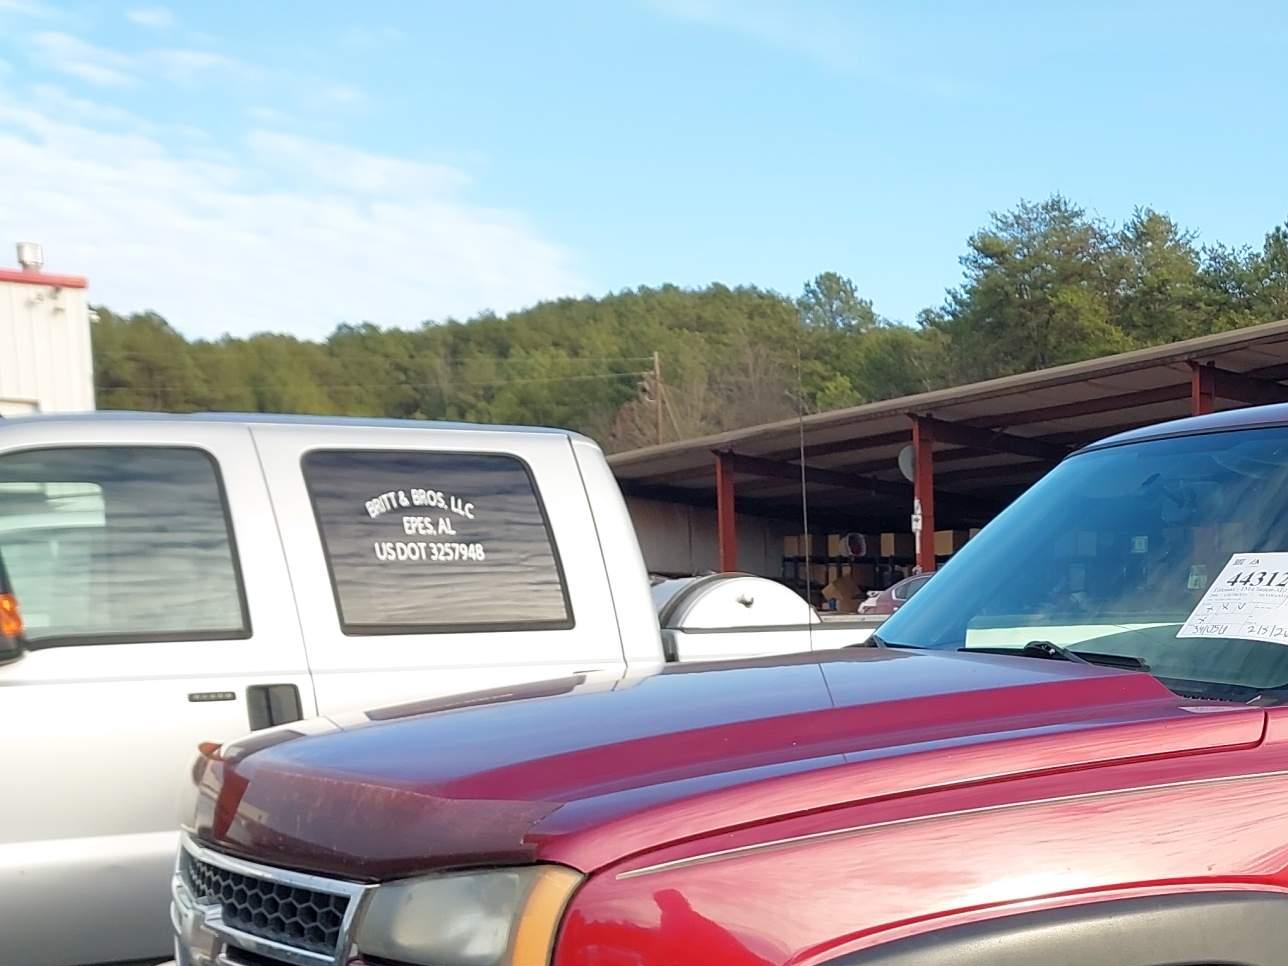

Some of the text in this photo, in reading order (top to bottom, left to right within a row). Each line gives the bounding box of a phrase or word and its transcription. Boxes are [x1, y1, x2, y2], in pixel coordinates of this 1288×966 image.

[365, 491, 398, 518] BRITT
[398, 490, 410, 507] &
[450, 495, 475, 519] LLC
[438, 517, 457, 535] AL
[429, 542, 486, 561] 3257948
